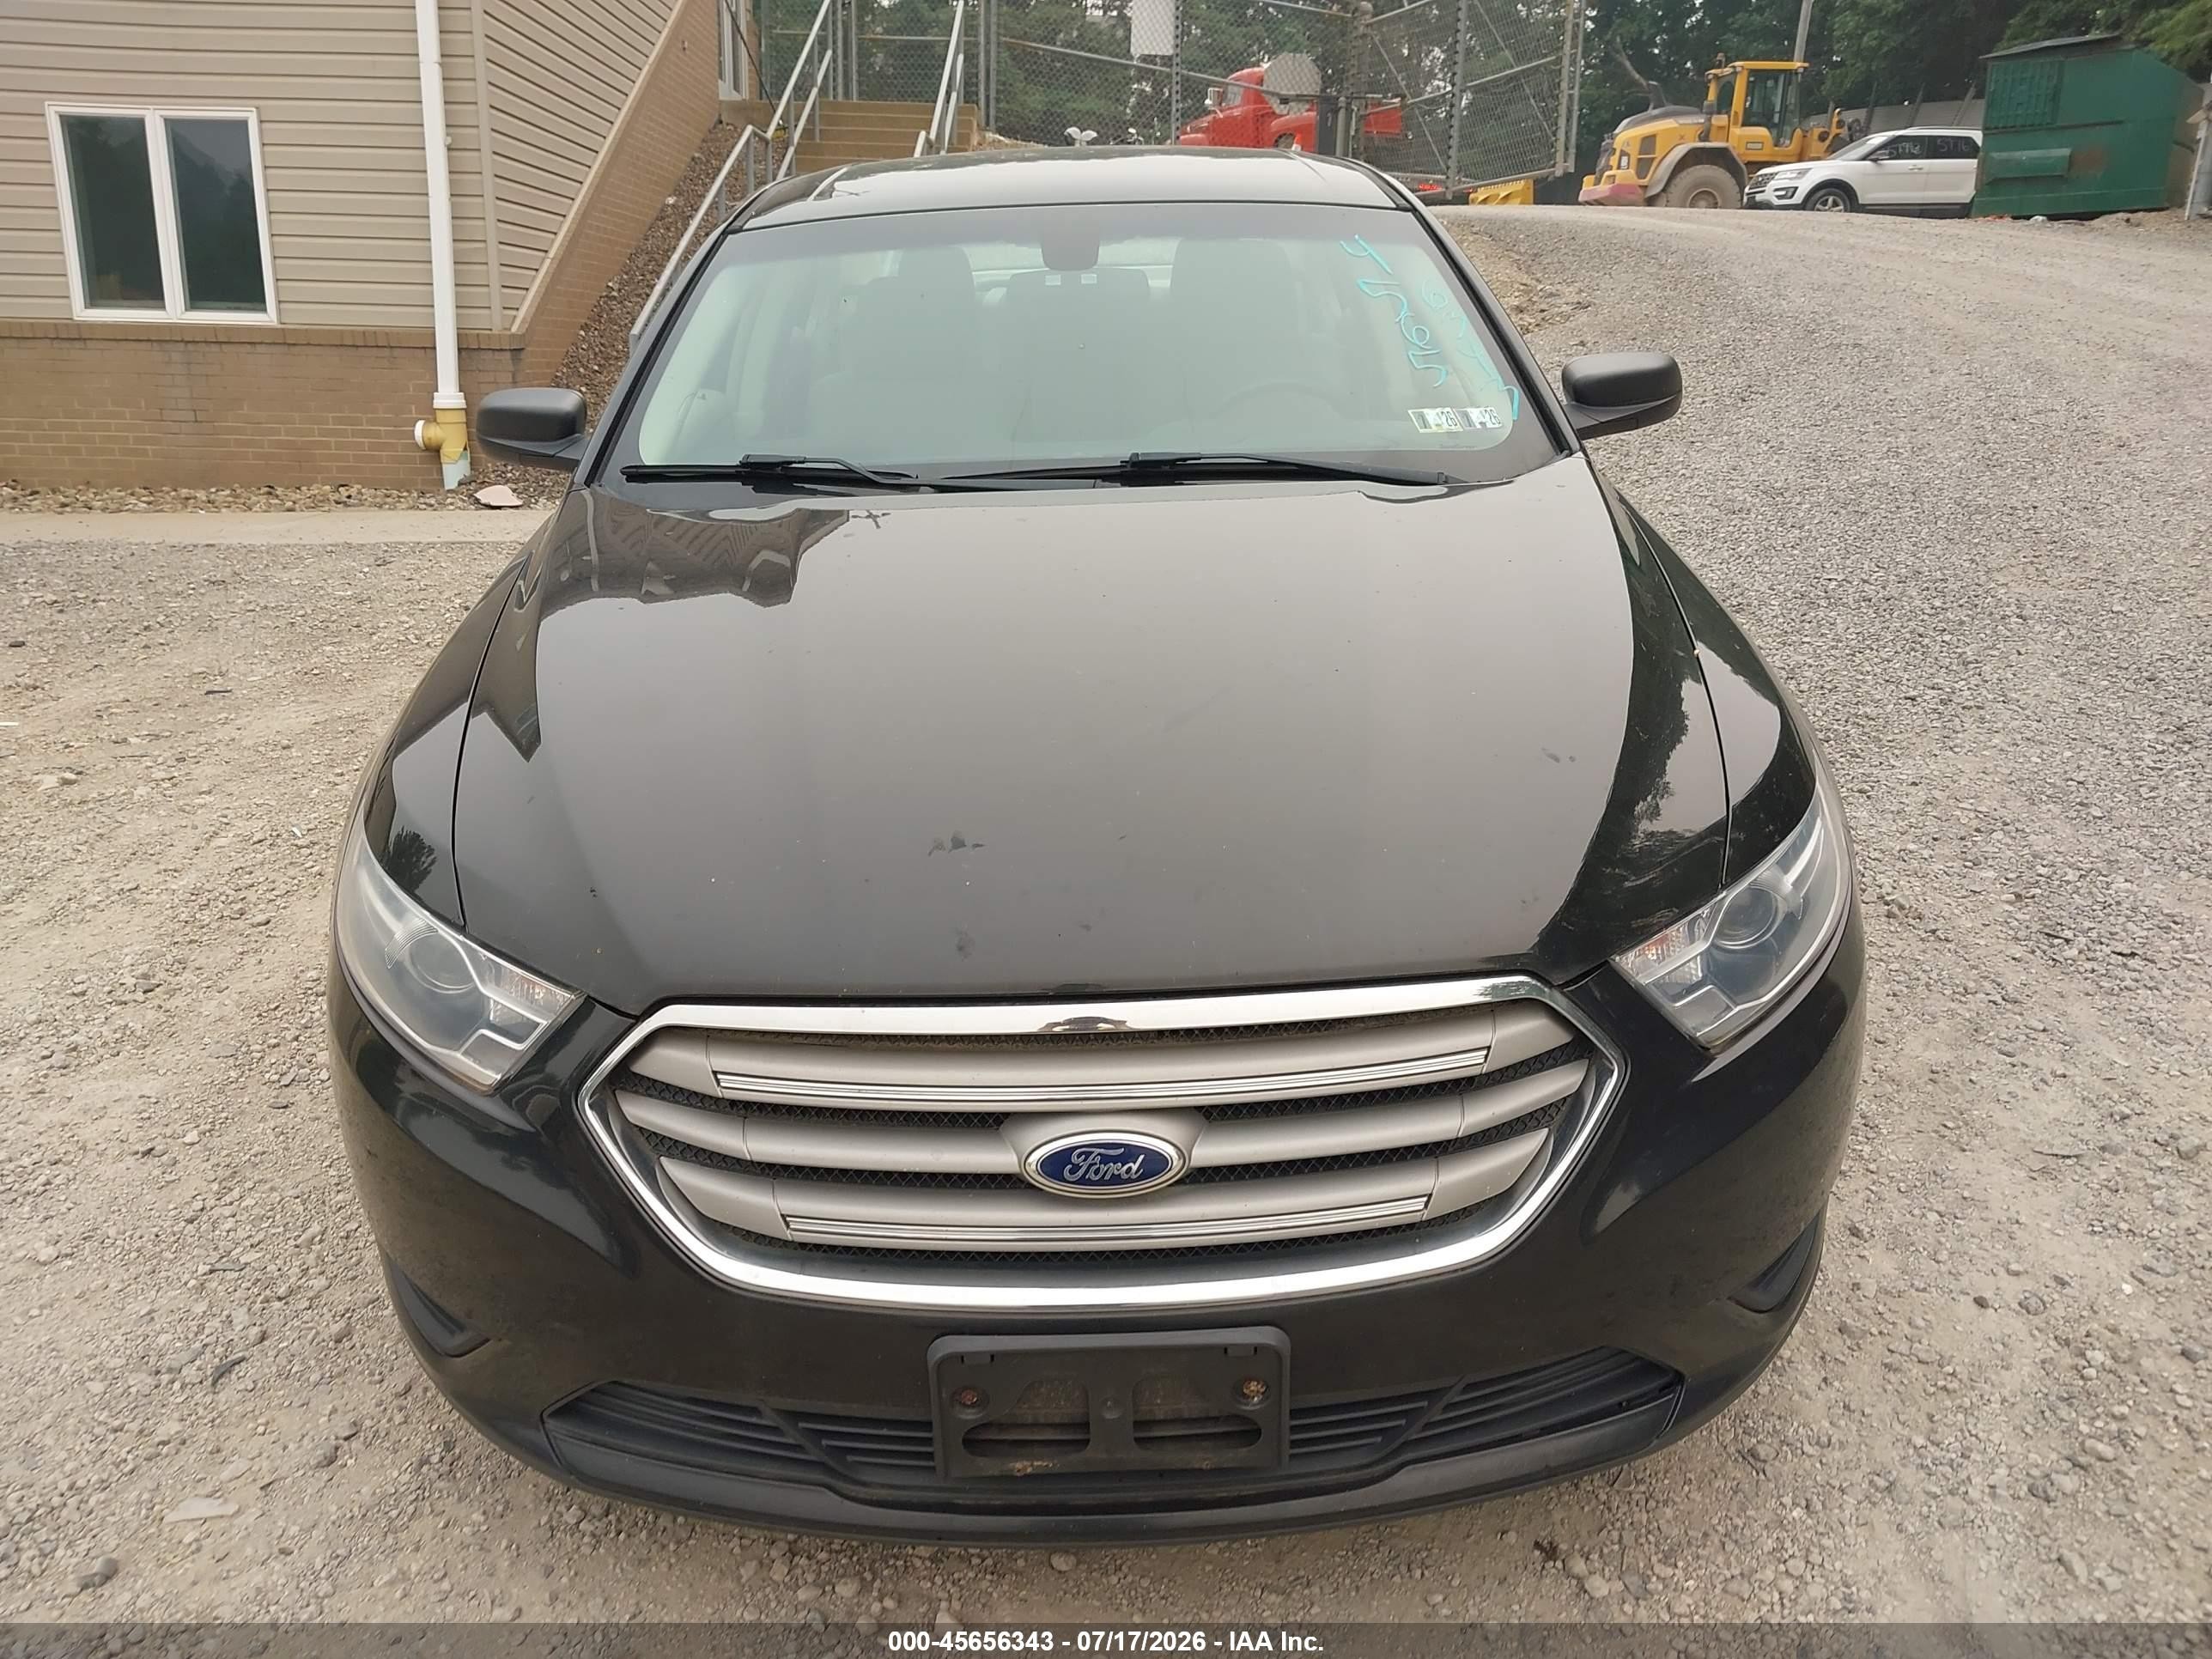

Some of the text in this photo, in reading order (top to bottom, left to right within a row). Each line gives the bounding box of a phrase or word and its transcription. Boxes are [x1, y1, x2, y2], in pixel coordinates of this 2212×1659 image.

[1441, 410, 1457, 427] 26
[1484, 409, 1501, 425] 26
[1063, 1147, 1146, 1182] Ford
